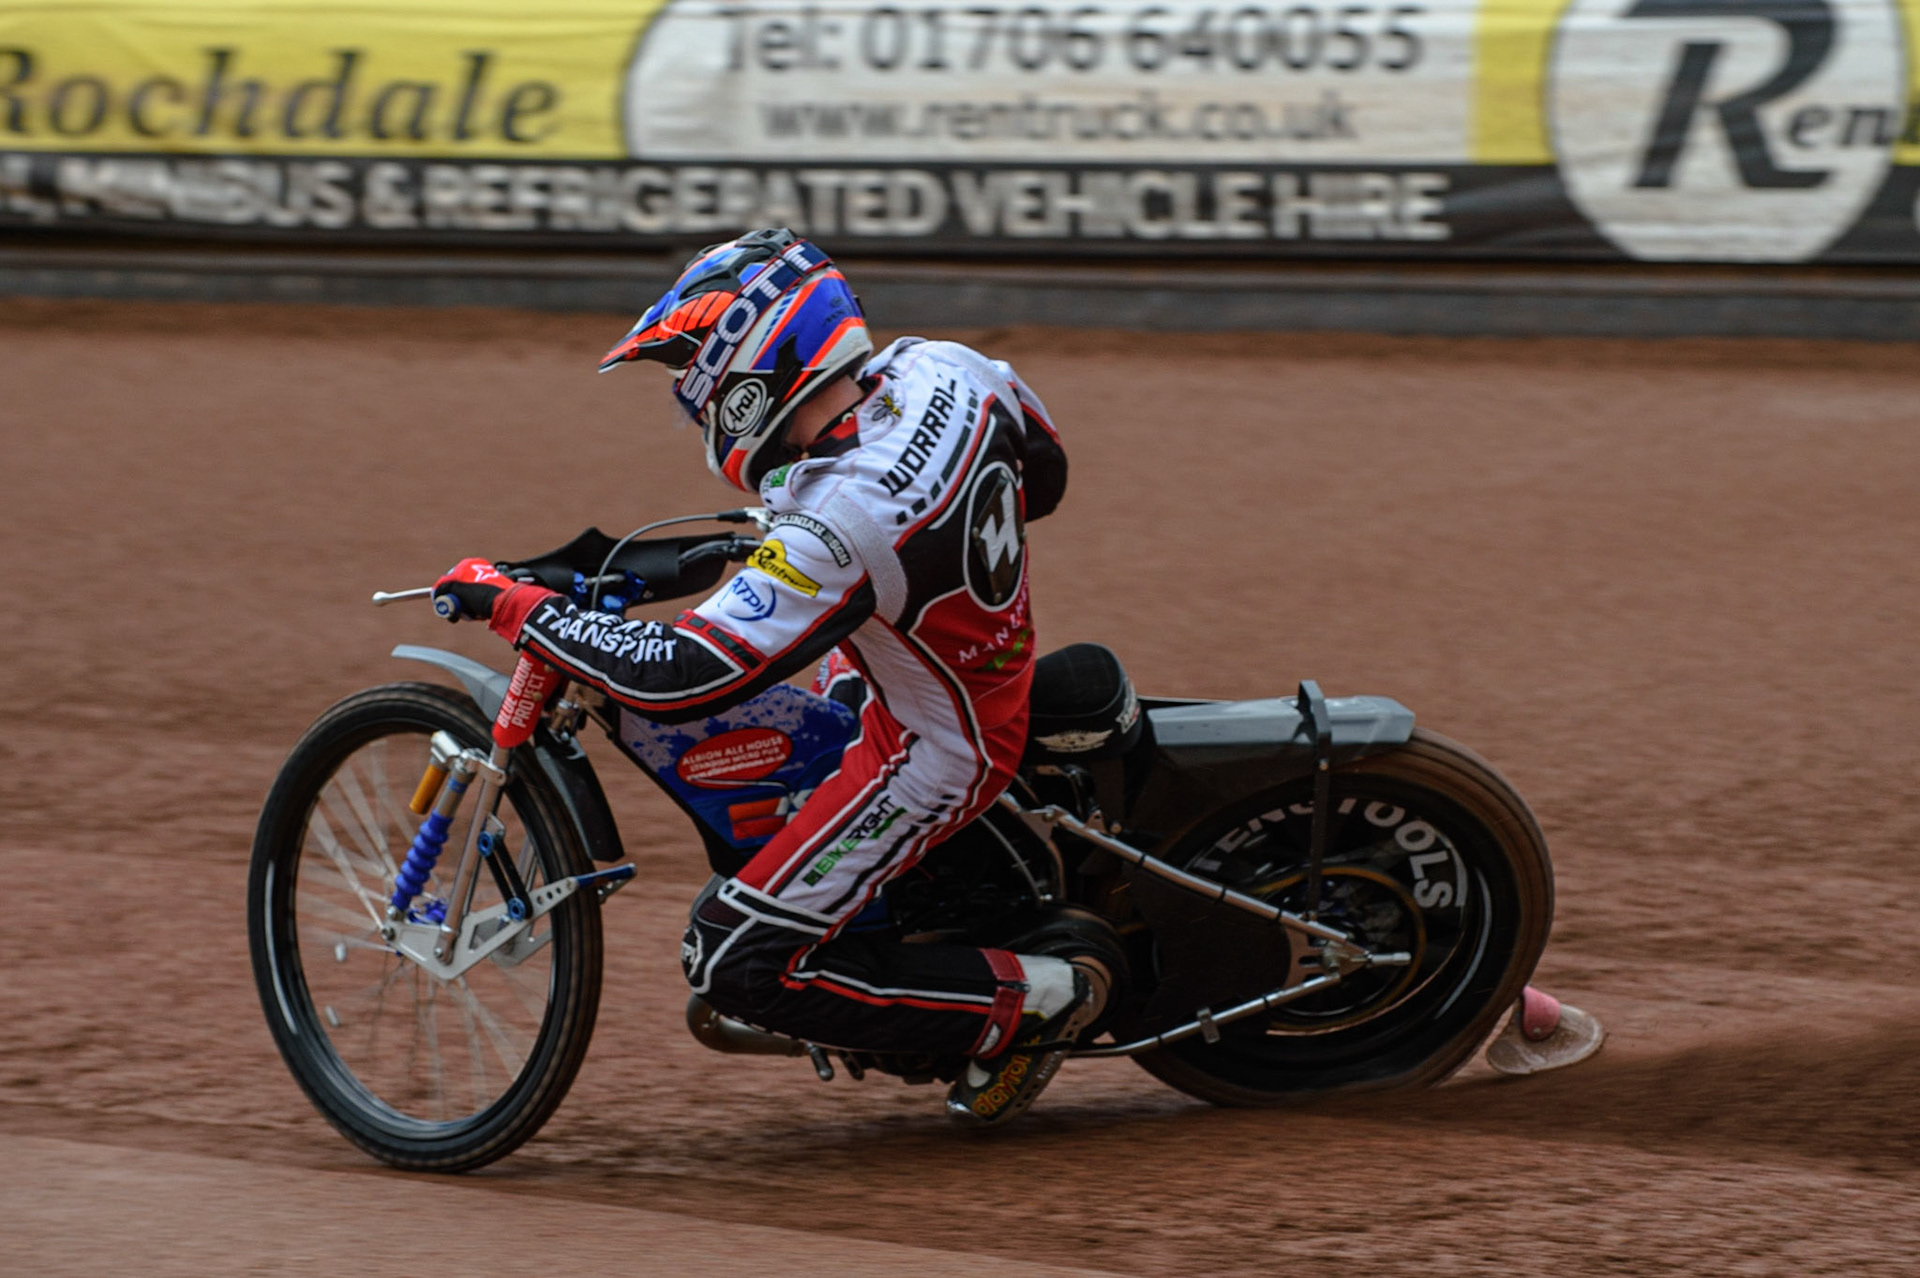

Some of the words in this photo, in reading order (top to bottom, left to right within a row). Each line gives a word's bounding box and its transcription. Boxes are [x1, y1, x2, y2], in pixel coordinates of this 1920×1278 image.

[860, 6, 1104, 72] 01706
[1127, 6, 1425, 72] 640055
[0, 46, 563, 144] Rochdale
[757, 90, 1358, 141] www.rentruck.co.uk
[361, 163, 420, 230] &
[422, 164, 948, 236] REFRIGERATED
[950, 168, 1266, 240] VEHICLE
[1272, 171, 1453, 242] HIRE
[680, 244, 814, 409] SCOTT
[727, 385, 757, 431] Arai
[877, 373, 957, 498] WORRAL
[682, 749, 723, 766] ALBION
[725, 744, 744, 757] ALE
[746, 735, 784, 750] HOUSE
